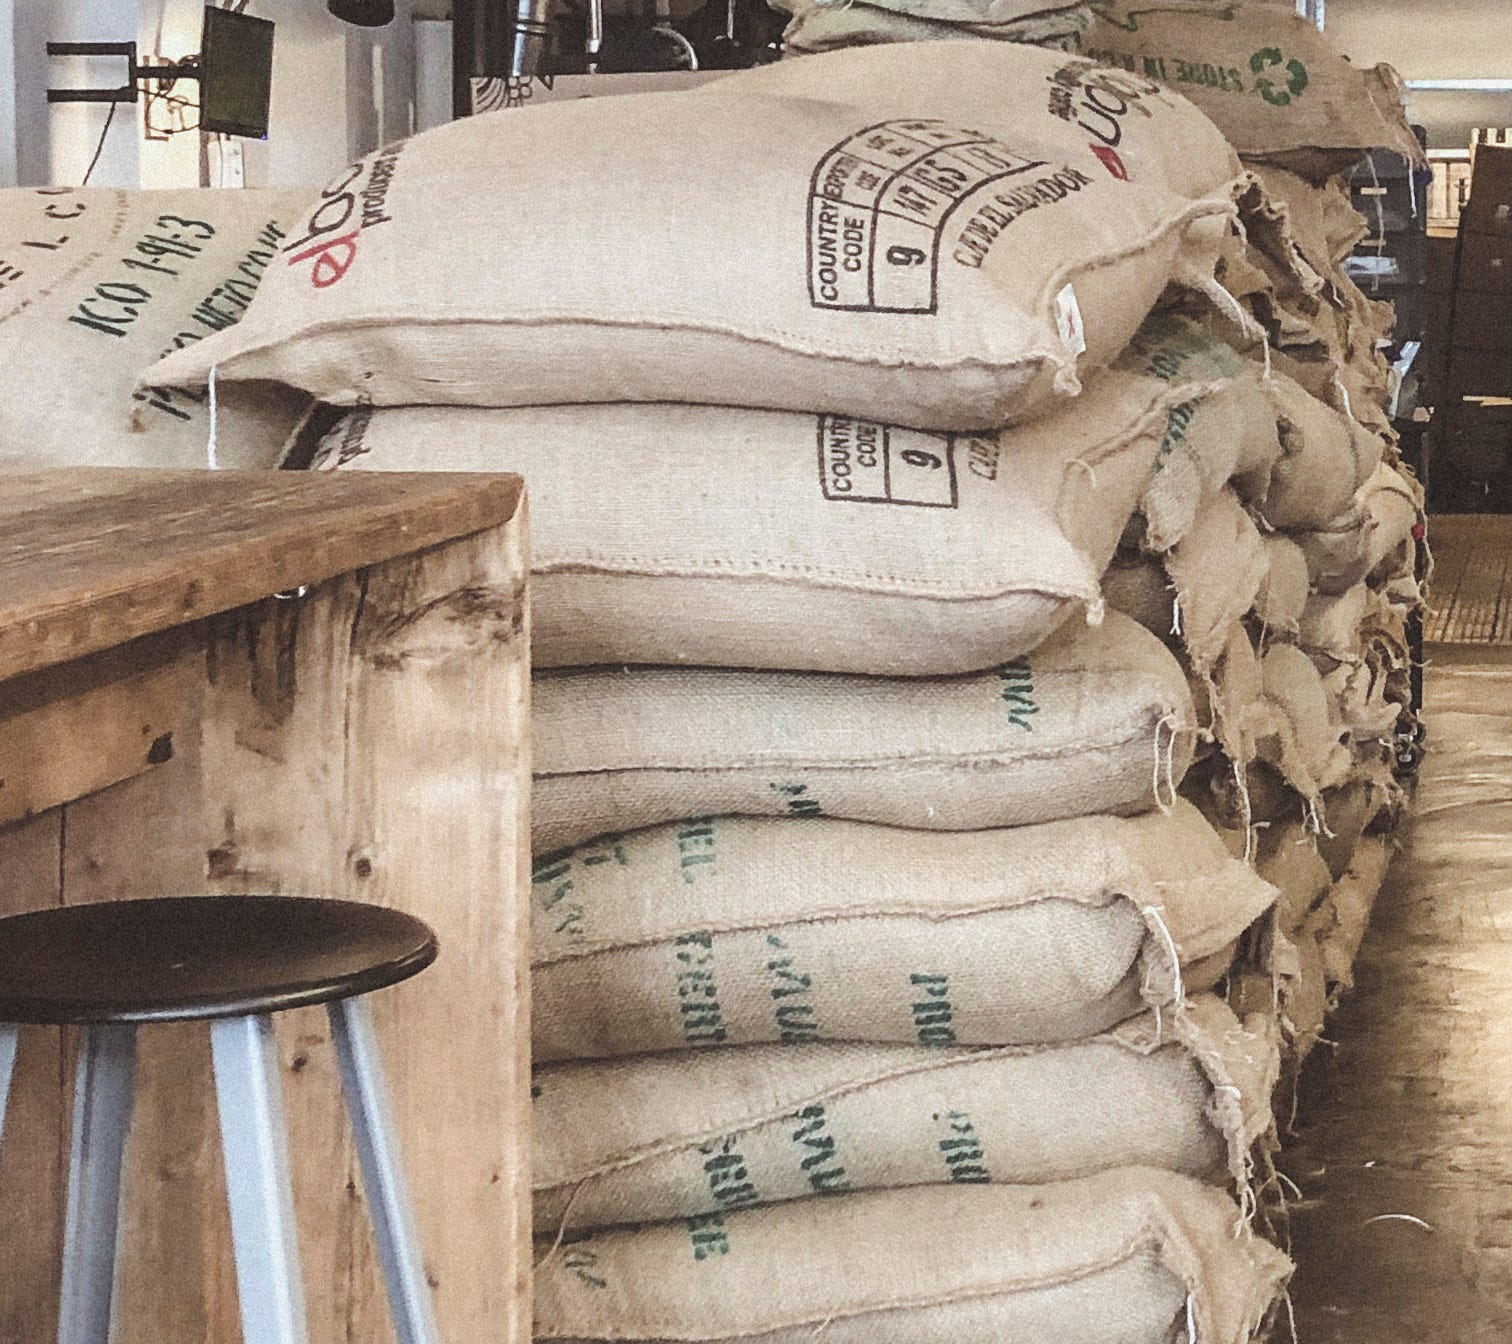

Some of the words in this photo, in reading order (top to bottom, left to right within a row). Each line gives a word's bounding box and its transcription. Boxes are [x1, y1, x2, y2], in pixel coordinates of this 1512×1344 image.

[818, 200, 840, 302] COUNTRY
[842, 217, 865, 273] CODE
[886, 244, 927, 266] 9
[68, 282, 152, 338] ICO
[901, 449, 942, 470] 9
